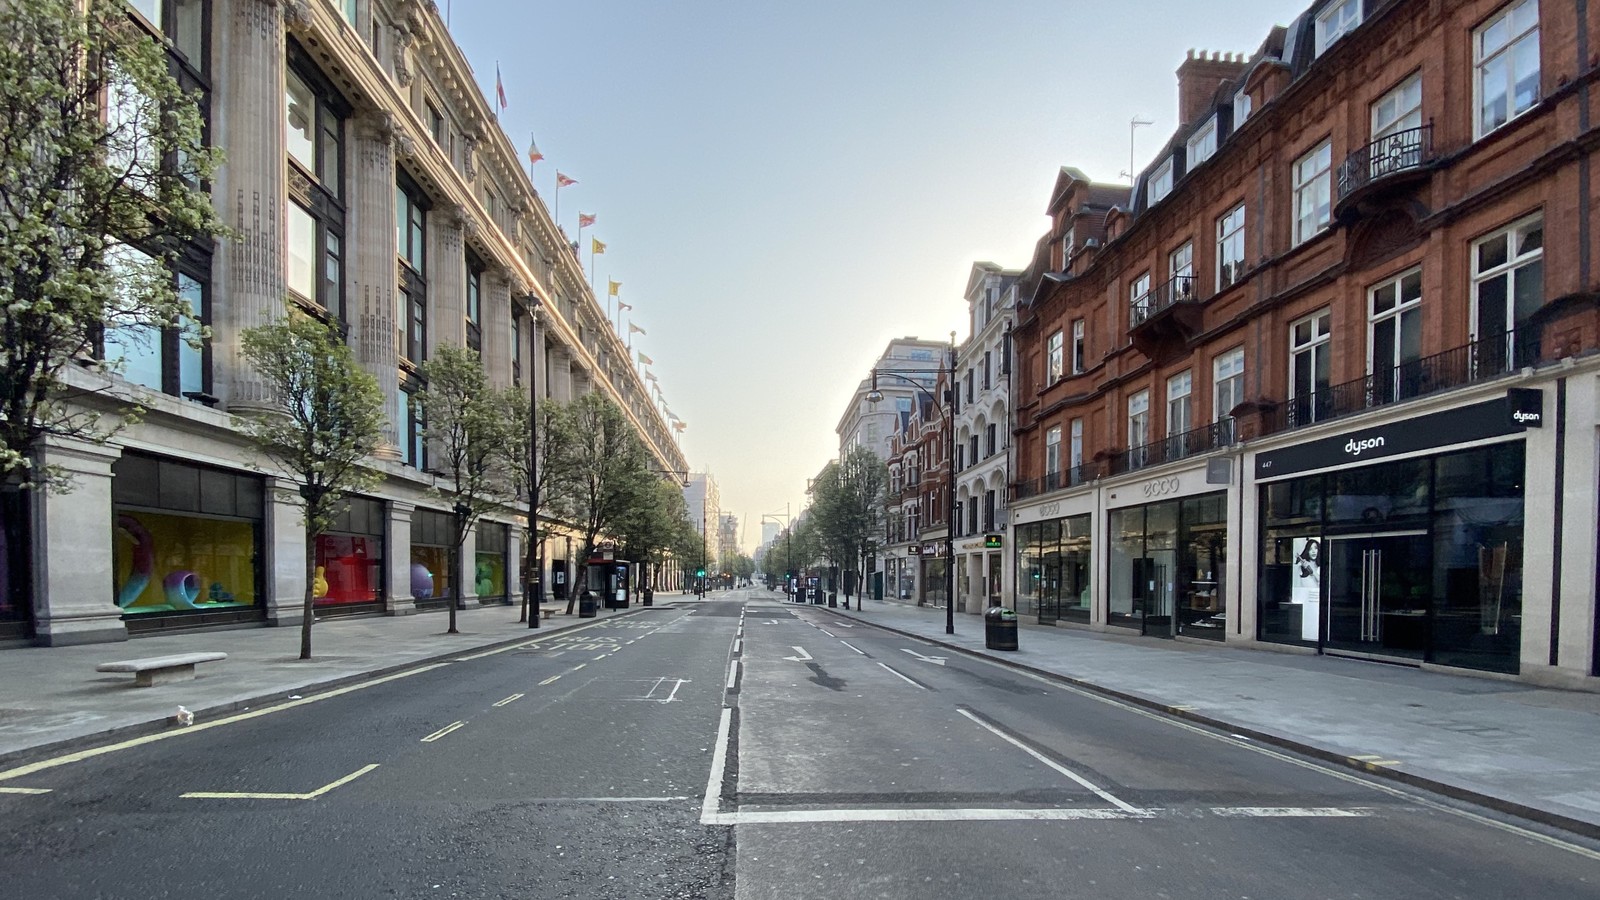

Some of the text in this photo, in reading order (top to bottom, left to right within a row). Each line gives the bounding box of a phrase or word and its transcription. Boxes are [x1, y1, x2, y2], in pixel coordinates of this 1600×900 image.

[1513, 410, 1540, 423] dyson
[1344, 436, 1385, 456] dyson
[1262, 460, 1272, 468] 447
[1144, 477, 1180, 498] ecco
[517, 643, 619, 651] STOP
